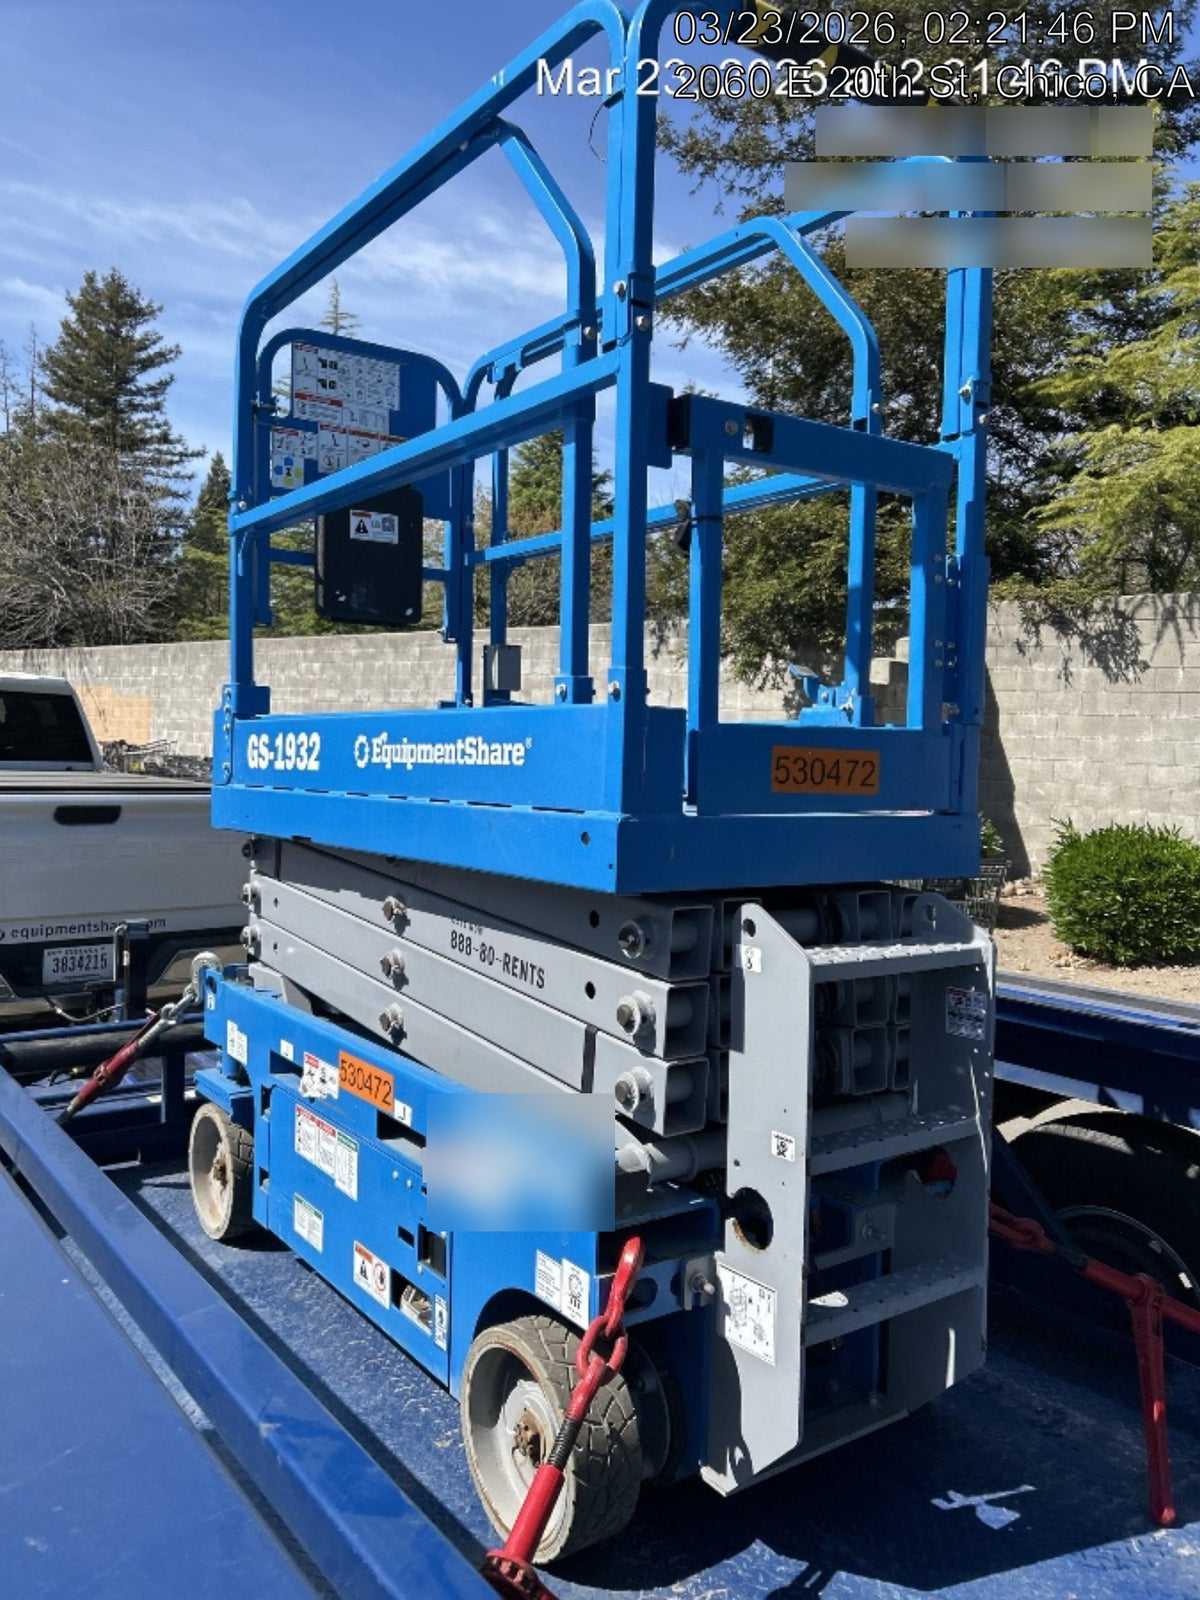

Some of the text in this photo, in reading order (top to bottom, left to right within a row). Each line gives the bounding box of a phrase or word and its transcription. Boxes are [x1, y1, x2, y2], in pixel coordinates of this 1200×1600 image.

[247, 731, 321, 771] GS-1932
[774, 755, 876, 788] 530472
[11, 917, 166, 939] equipmentsharom
[450, 929, 545, 989] 888-80-RENTS
[339, 1058, 392, 1106] 530472
